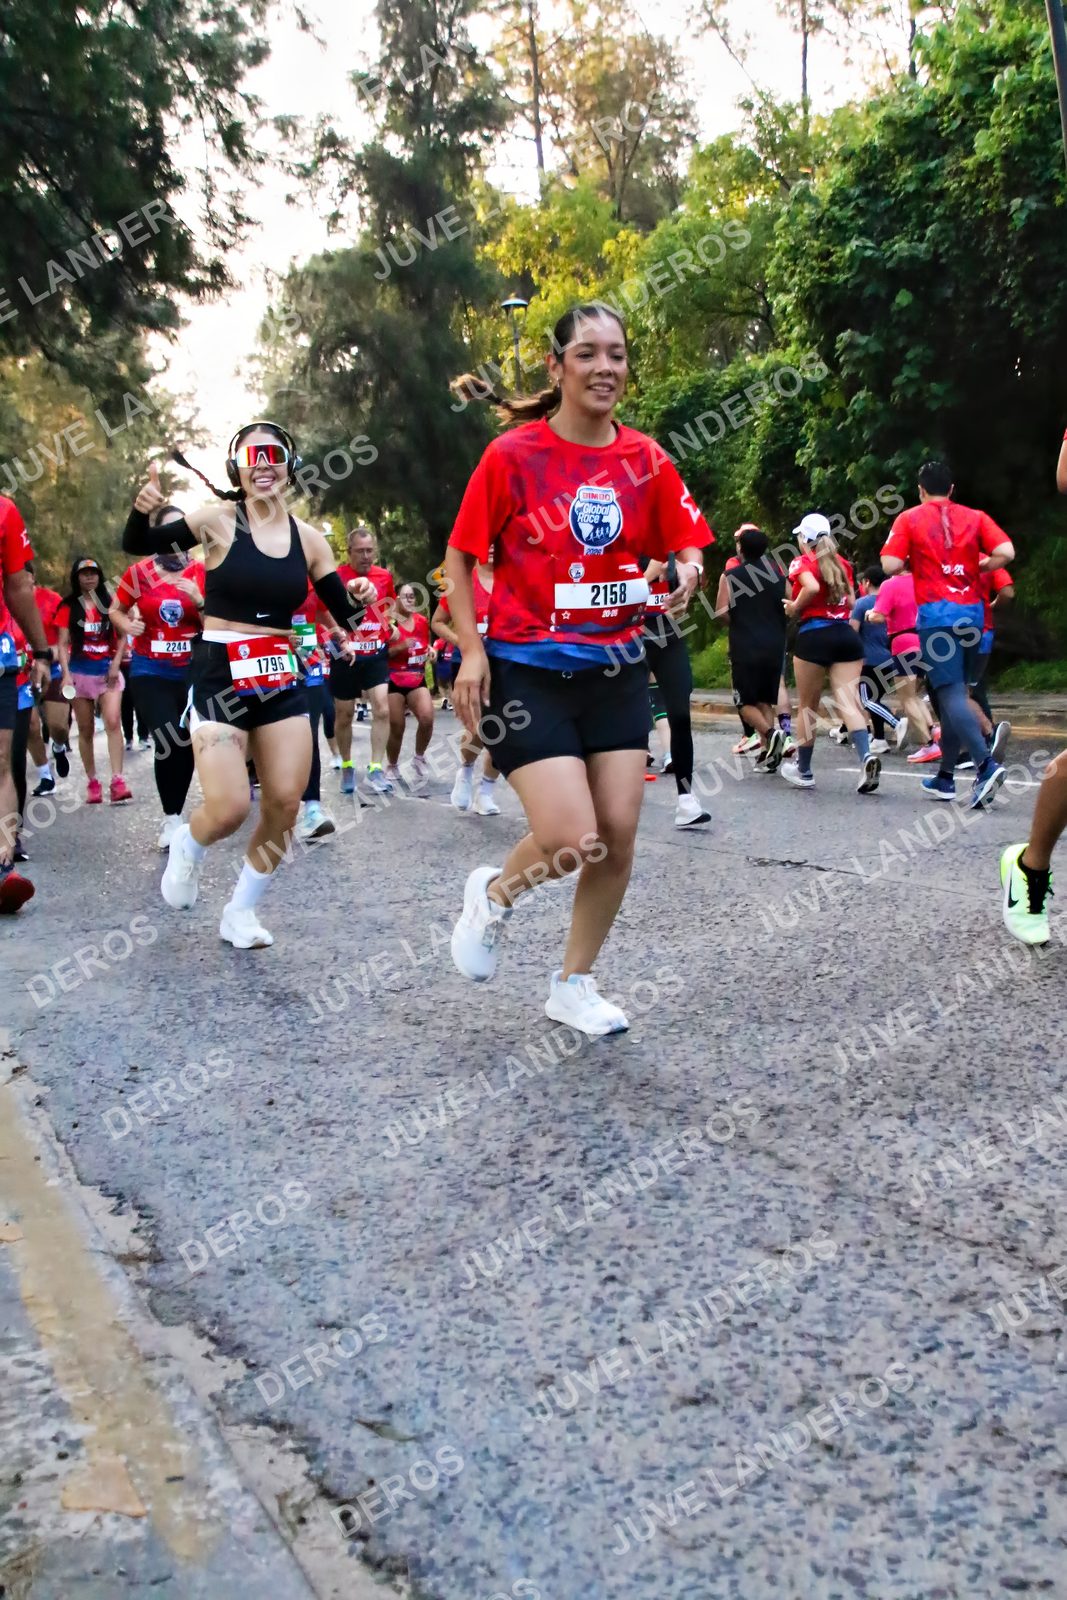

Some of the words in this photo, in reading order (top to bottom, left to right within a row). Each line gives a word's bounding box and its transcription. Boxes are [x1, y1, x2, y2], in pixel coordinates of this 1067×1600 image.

[583, 503, 610, 516] Global
[577, 512, 600, 524] Race
[591, 582, 627, 606] 2158
[166, 642, 187, 652] 2244
[257, 656, 285, 674] 1796
